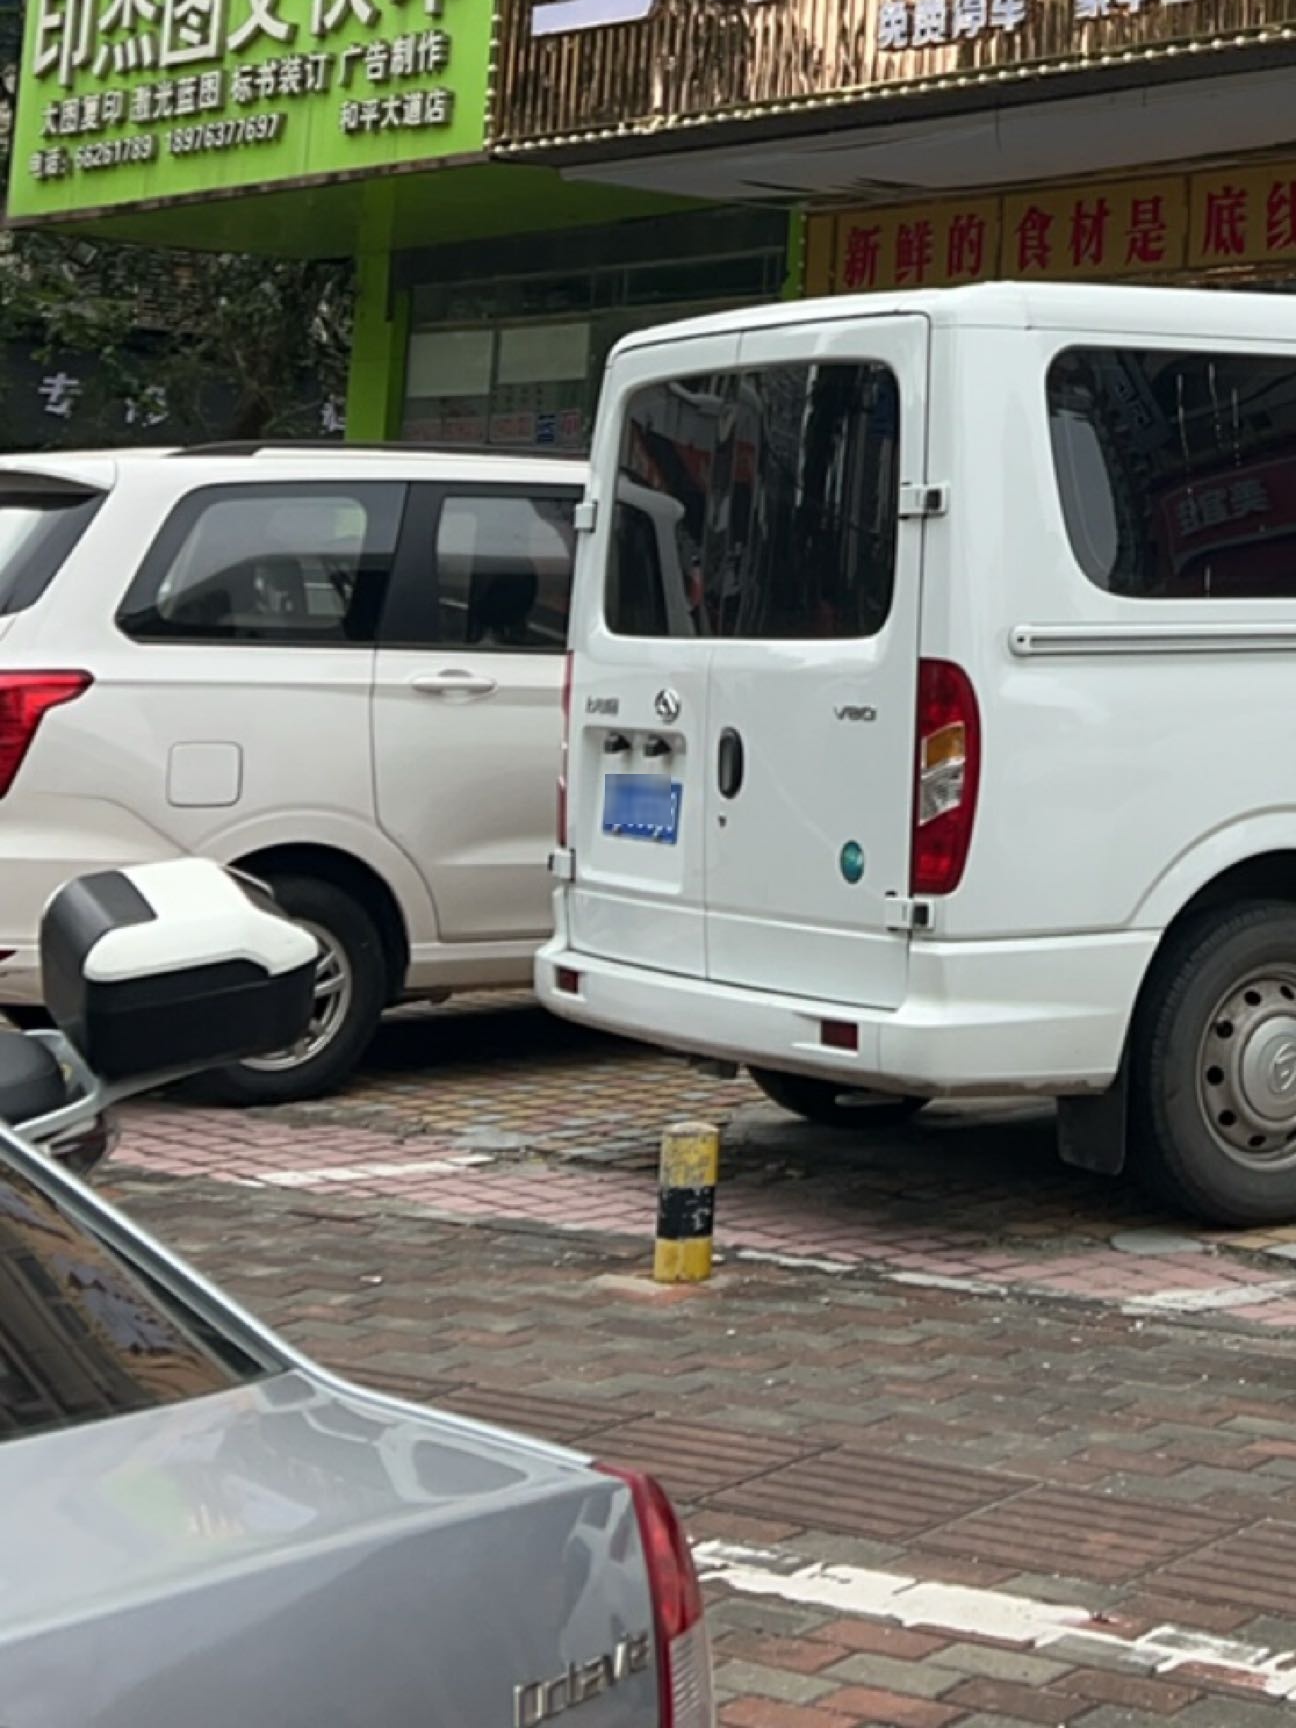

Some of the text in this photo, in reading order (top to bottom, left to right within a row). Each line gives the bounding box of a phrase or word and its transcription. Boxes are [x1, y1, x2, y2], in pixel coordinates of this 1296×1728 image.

[338, 29, 449, 86] 广告制作
[340, 87, 452, 133] 和平大道店
